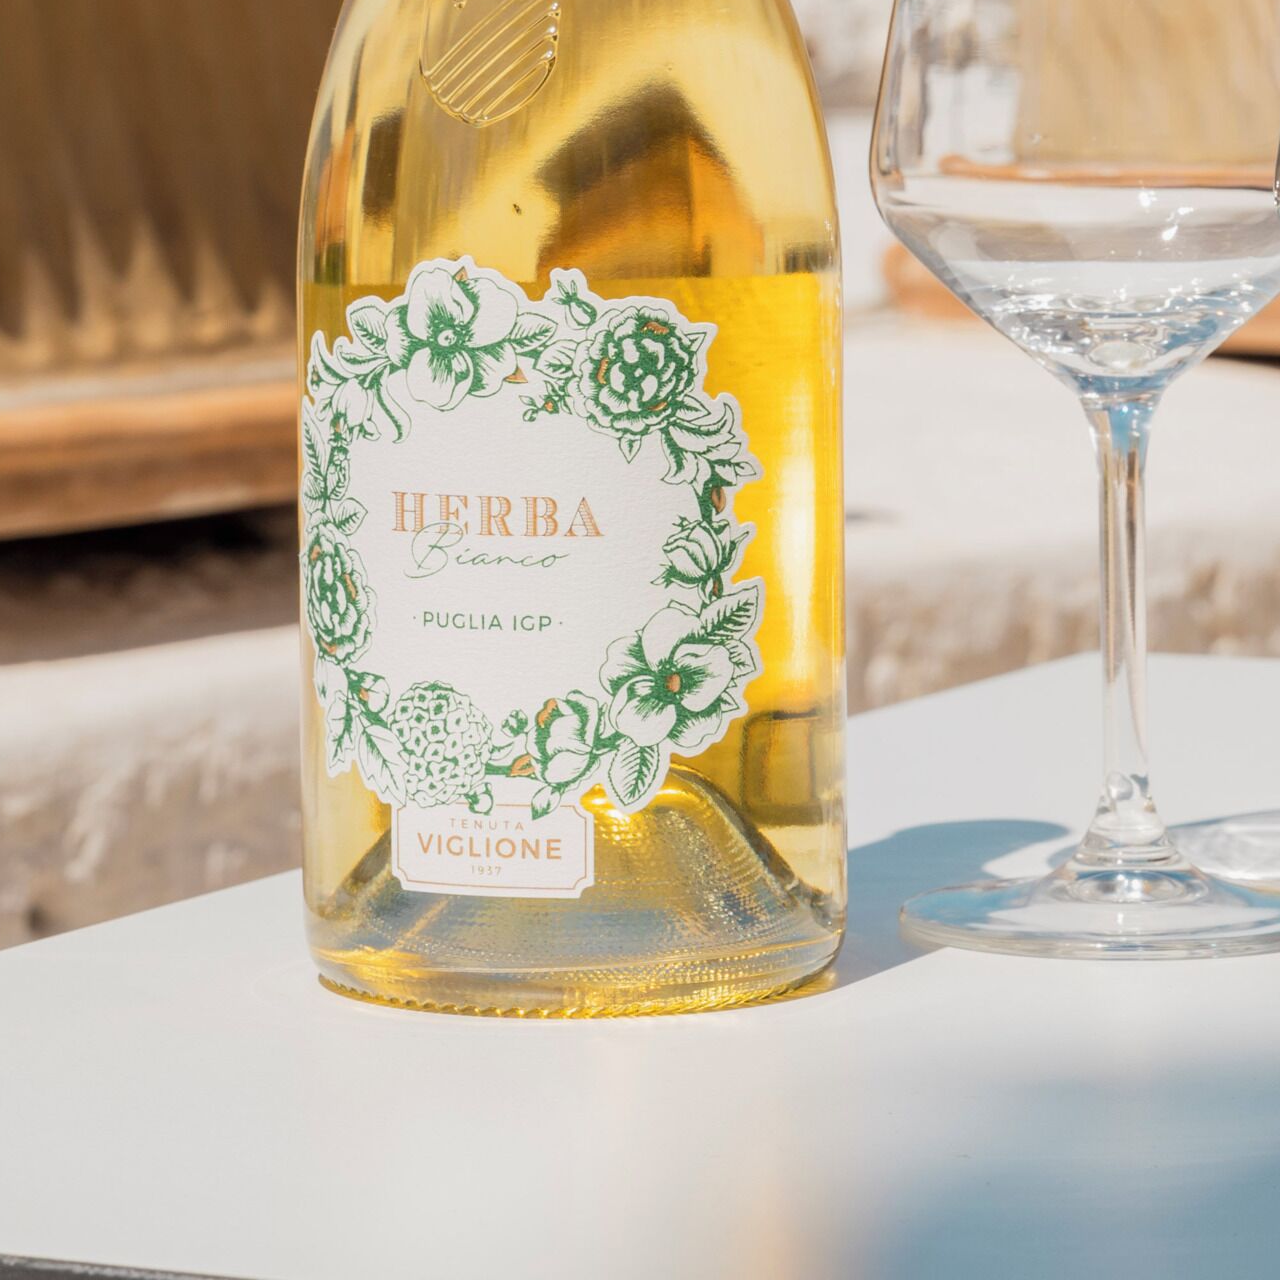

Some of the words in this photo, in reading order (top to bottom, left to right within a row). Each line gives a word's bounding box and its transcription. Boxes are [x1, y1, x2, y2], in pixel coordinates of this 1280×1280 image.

[391, 490, 605, 538] HERBA
[403, 522, 570, 579] Bianco
[422, 610, 503, 631] PUGLIA
[512, 614, 552, 632] IGP
[450, 817, 525, 831] TENUTA
[417, 832, 562, 860] VIGLIONE
[471, 864, 502, 876] 1937
